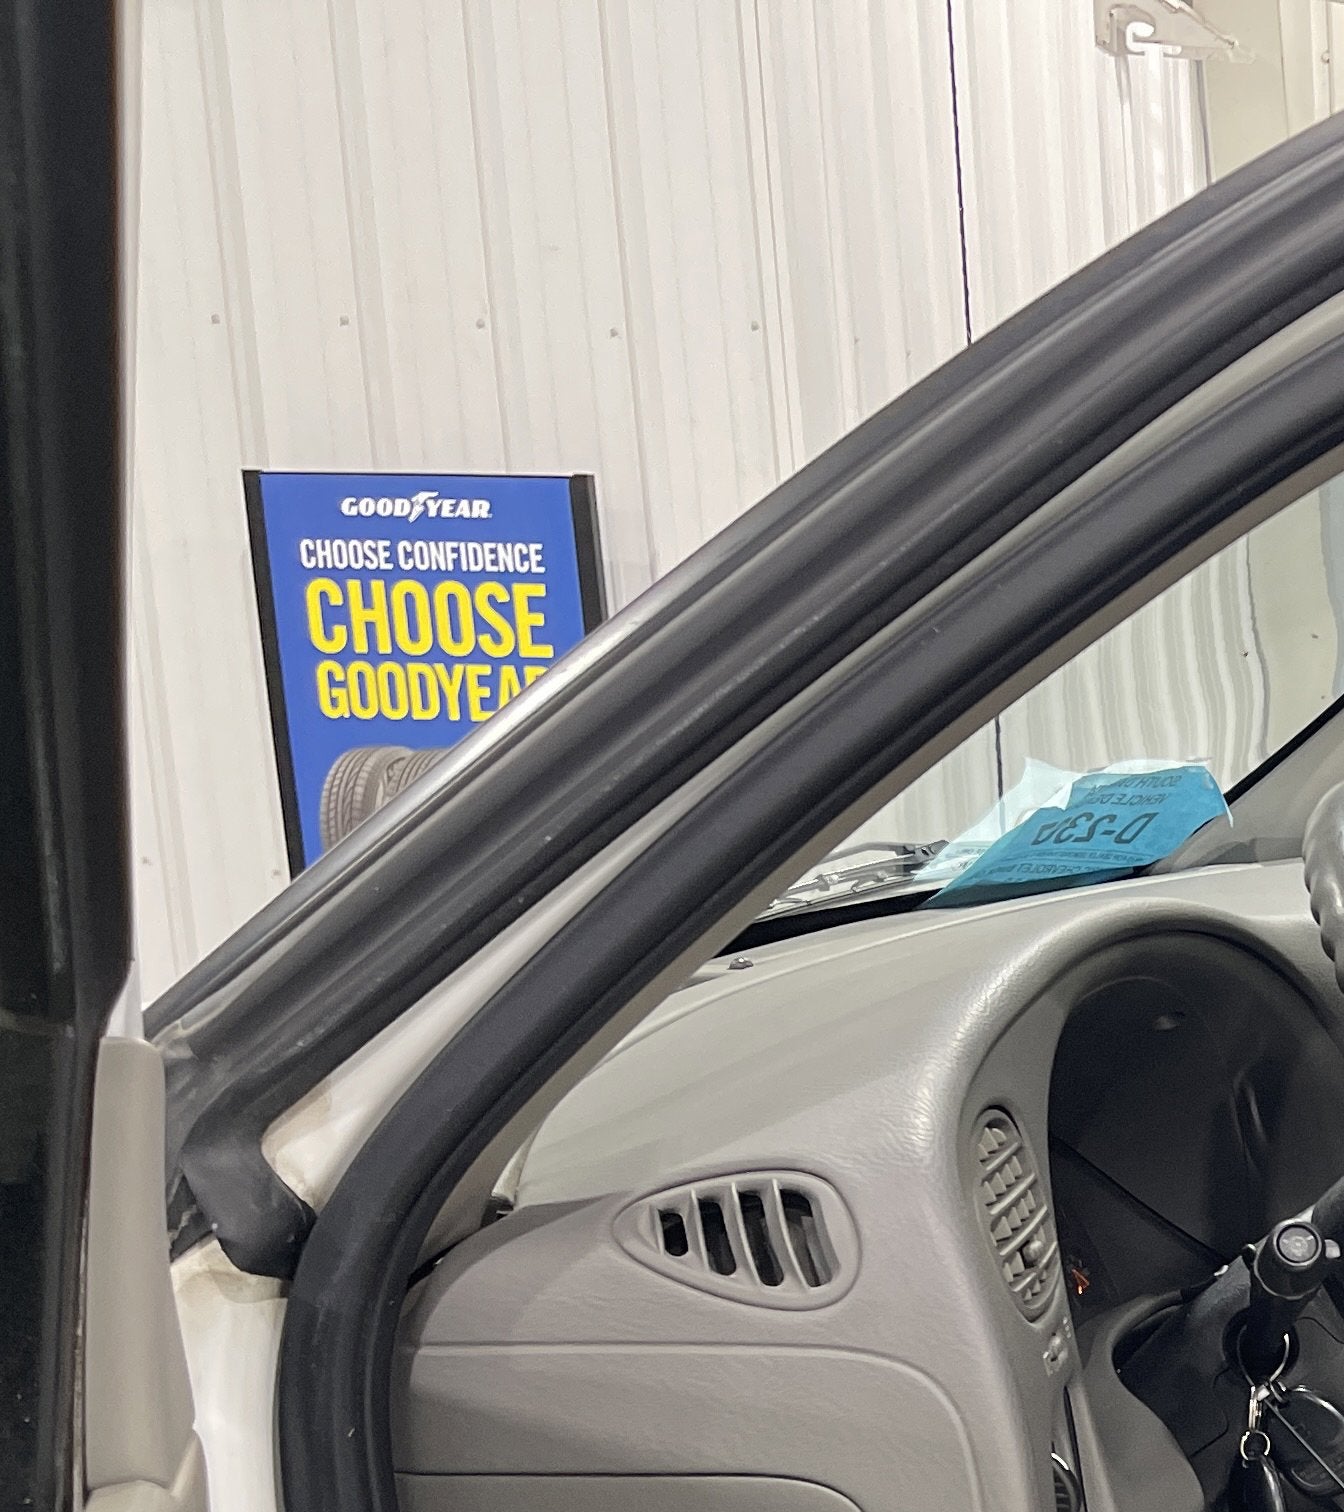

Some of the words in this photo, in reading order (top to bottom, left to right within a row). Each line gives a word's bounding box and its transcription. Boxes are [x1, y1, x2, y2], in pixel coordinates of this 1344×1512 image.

[340, 491, 492, 523] GOODYEAR
[300, 538, 394, 570] CHOOSE
[398, 540, 546, 573] CONFIDENCE
[306, 577, 554, 658] CHOOSE
